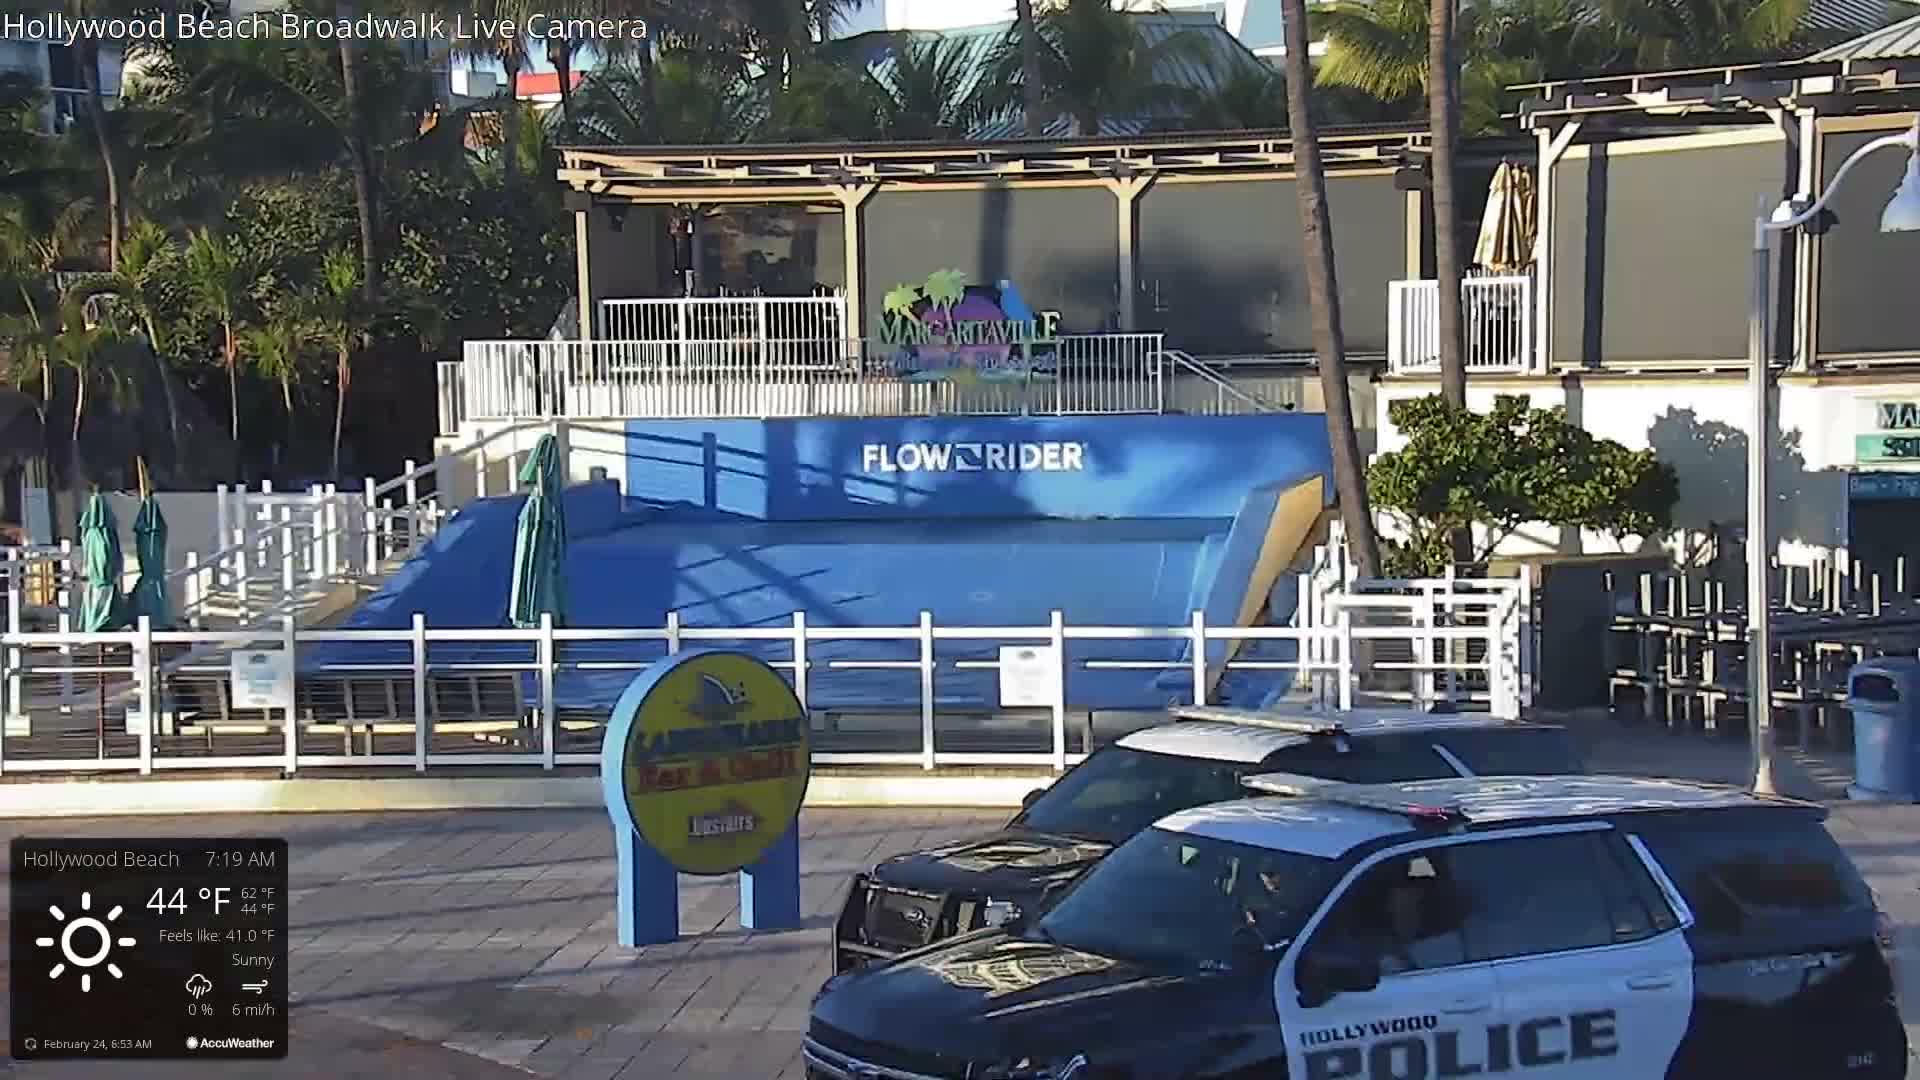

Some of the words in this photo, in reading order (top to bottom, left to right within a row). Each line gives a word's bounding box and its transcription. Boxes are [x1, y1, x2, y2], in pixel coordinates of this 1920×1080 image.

[1876, 401, 1920, 429] MA
[1300, 1014, 1438, 1047] HOLLYWOOD
[1304, 1008, 1620, 1080] POLICE
